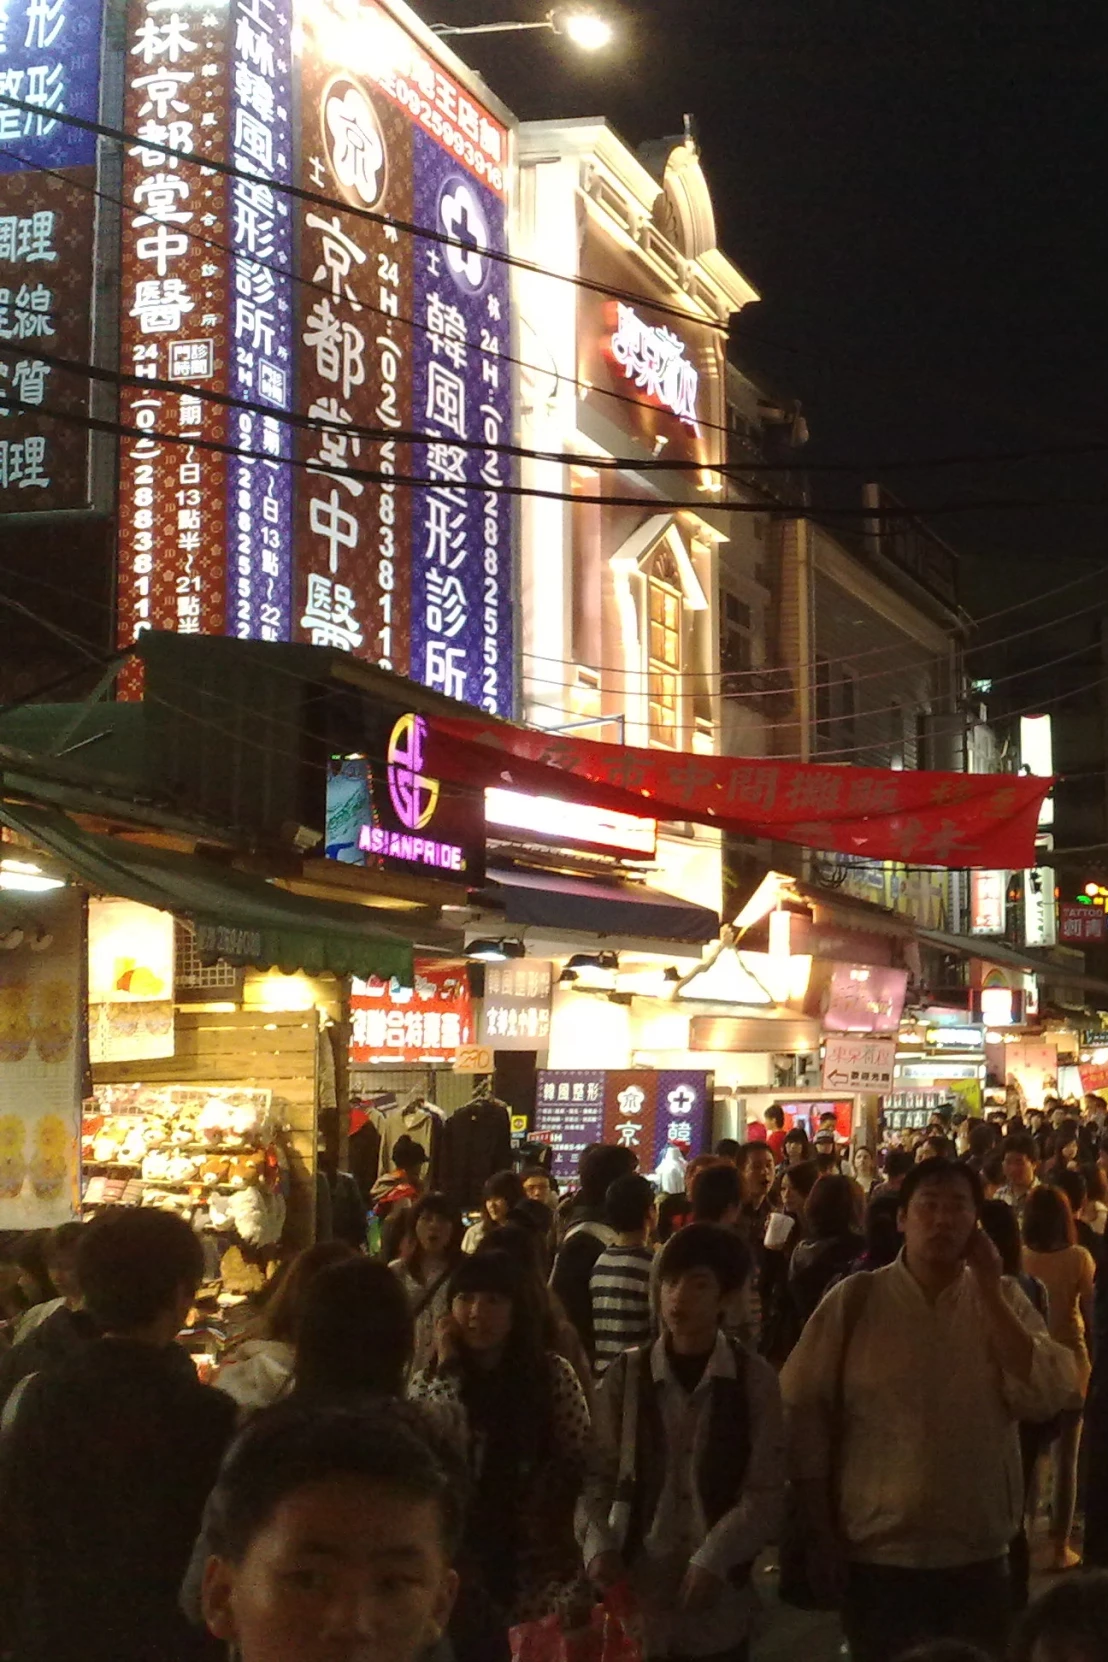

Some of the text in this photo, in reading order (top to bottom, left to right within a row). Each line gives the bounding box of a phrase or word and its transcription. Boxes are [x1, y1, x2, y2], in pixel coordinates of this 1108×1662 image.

[301, 212, 367, 652] 京都堂中醫
[424, 292, 468, 701] 韓風整形診所
[358, 824, 463, 871] ASIANPRIDE
[614, 1120, 643, 1147] 京
